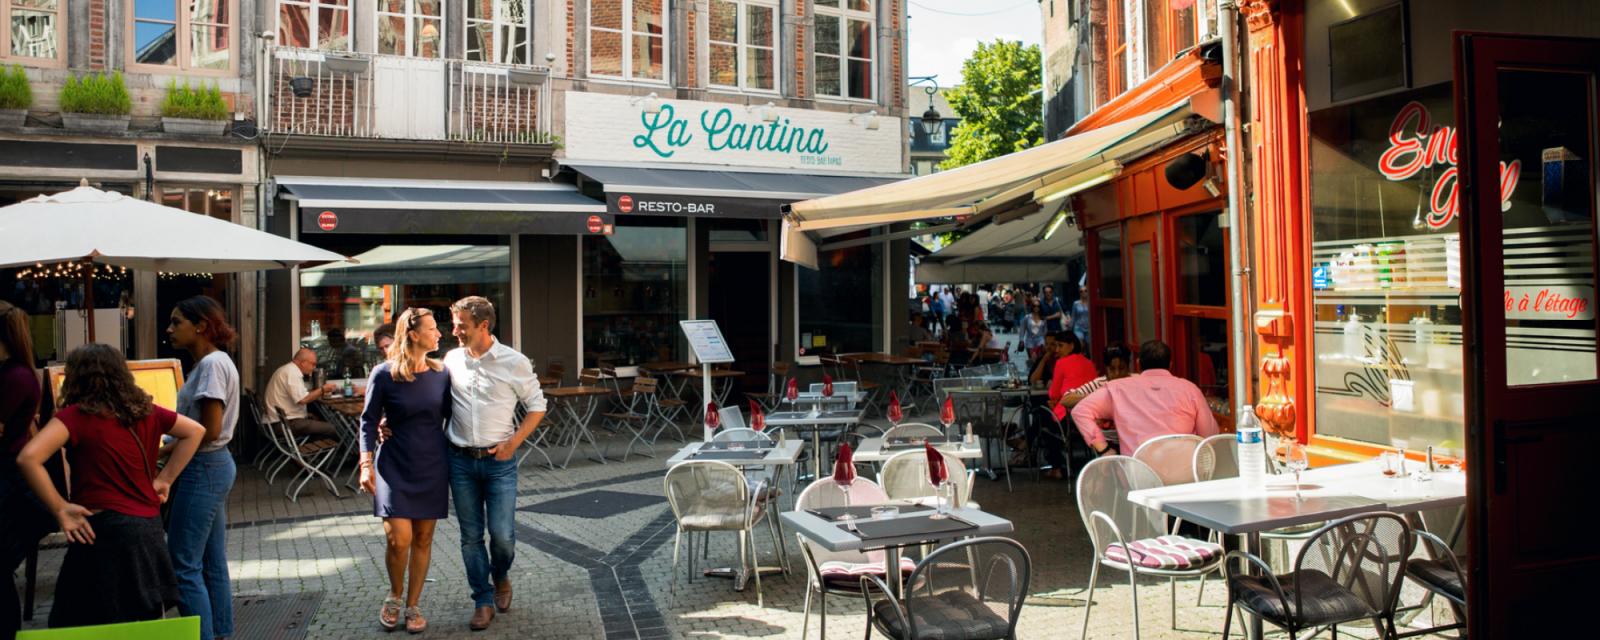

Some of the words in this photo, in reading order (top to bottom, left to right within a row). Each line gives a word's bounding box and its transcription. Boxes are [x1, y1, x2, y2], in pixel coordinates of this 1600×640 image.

[633, 103, 692, 158] La
[700, 107, 829, 155] Cantina
[638, 201, 715, 214] RESTO-BAR
[1518, 293, 1530, 312] à
[1534, 289, 1589, 319] l'étage
